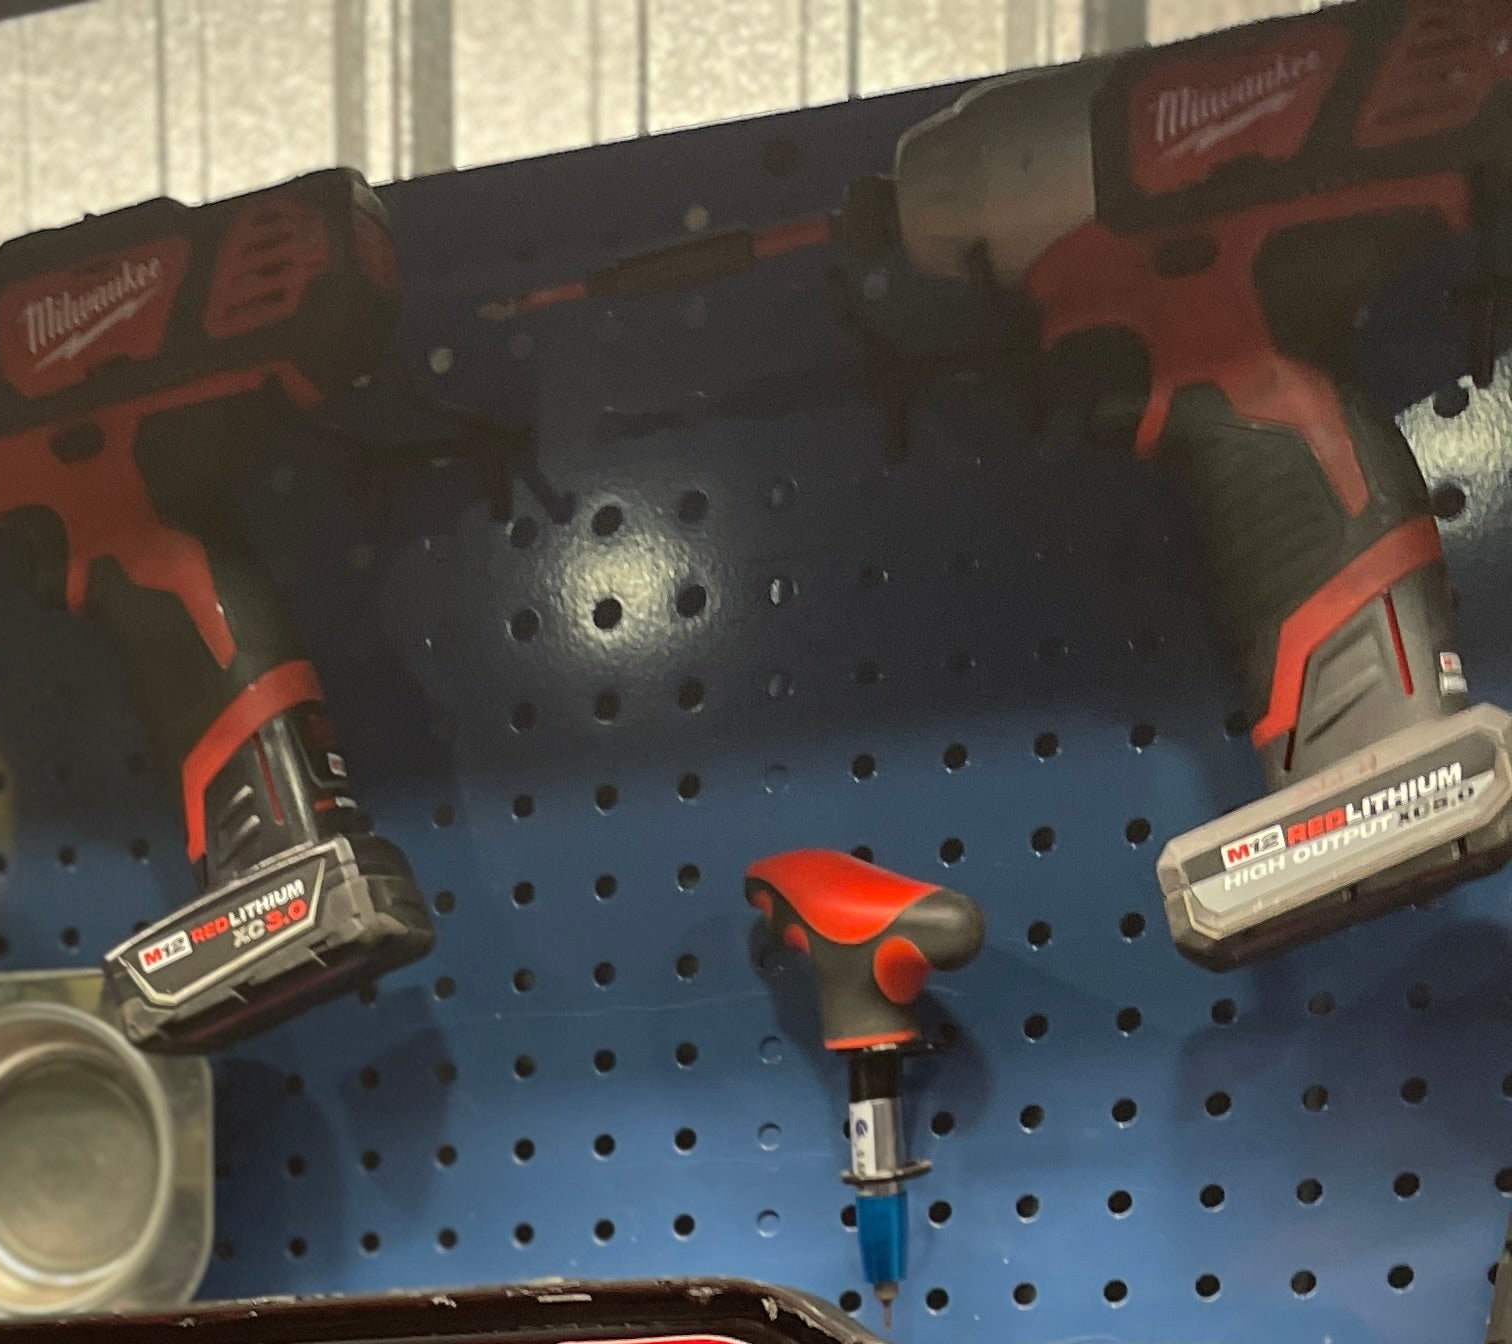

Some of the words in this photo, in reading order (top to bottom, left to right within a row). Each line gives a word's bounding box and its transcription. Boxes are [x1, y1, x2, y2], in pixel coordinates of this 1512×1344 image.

[1145, 50, 1321, 143] Milwaukee
[22, 256, 161, 355] Milwaukee
[1224, 855, 1286, 890] HIGH
[1293, 813, 1393, 865] OUTPUT
[1226, 830, 1280, 864] M12
[143, 935, 186, 966] M12
[232, 898, 308, 948] XC3.0
